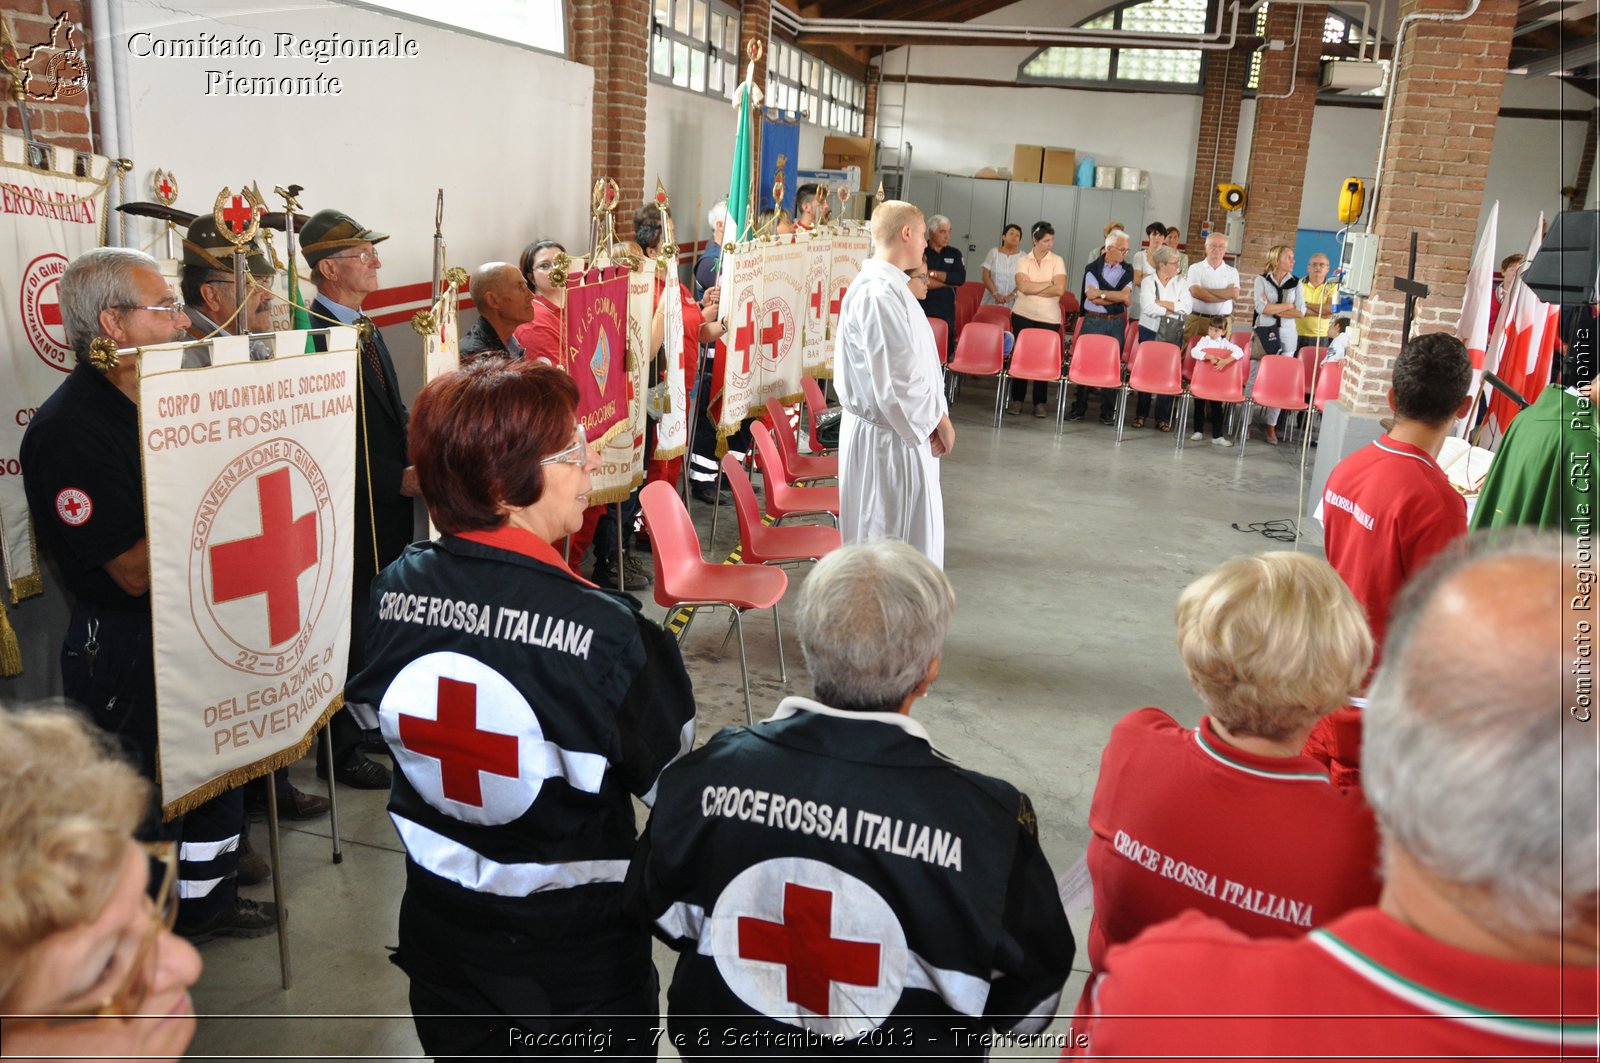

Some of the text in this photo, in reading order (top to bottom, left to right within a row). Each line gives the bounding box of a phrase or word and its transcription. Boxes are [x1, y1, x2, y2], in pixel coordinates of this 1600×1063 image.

[148, 394, 354, 451] CROCE ROSSA ITALIANA
[158, 370, 346, 418] CORPO VOLONTARI DEL SOCCORSO
[193, 442, 330, 551] CONVENZIONE DI GINEVRA
[379, 591, 594, 660] CROCE ROSSA ITALIANA
[204, 642, 335, 728] DELEGAZIONE DI
[214, 672, 334, 755] PEVERAGNO
[701, 785, 962, 872] CROCE ROSSA ITALIANA
[1114, 829, 1313, 927] CROCE ROSSA ITALIANA
